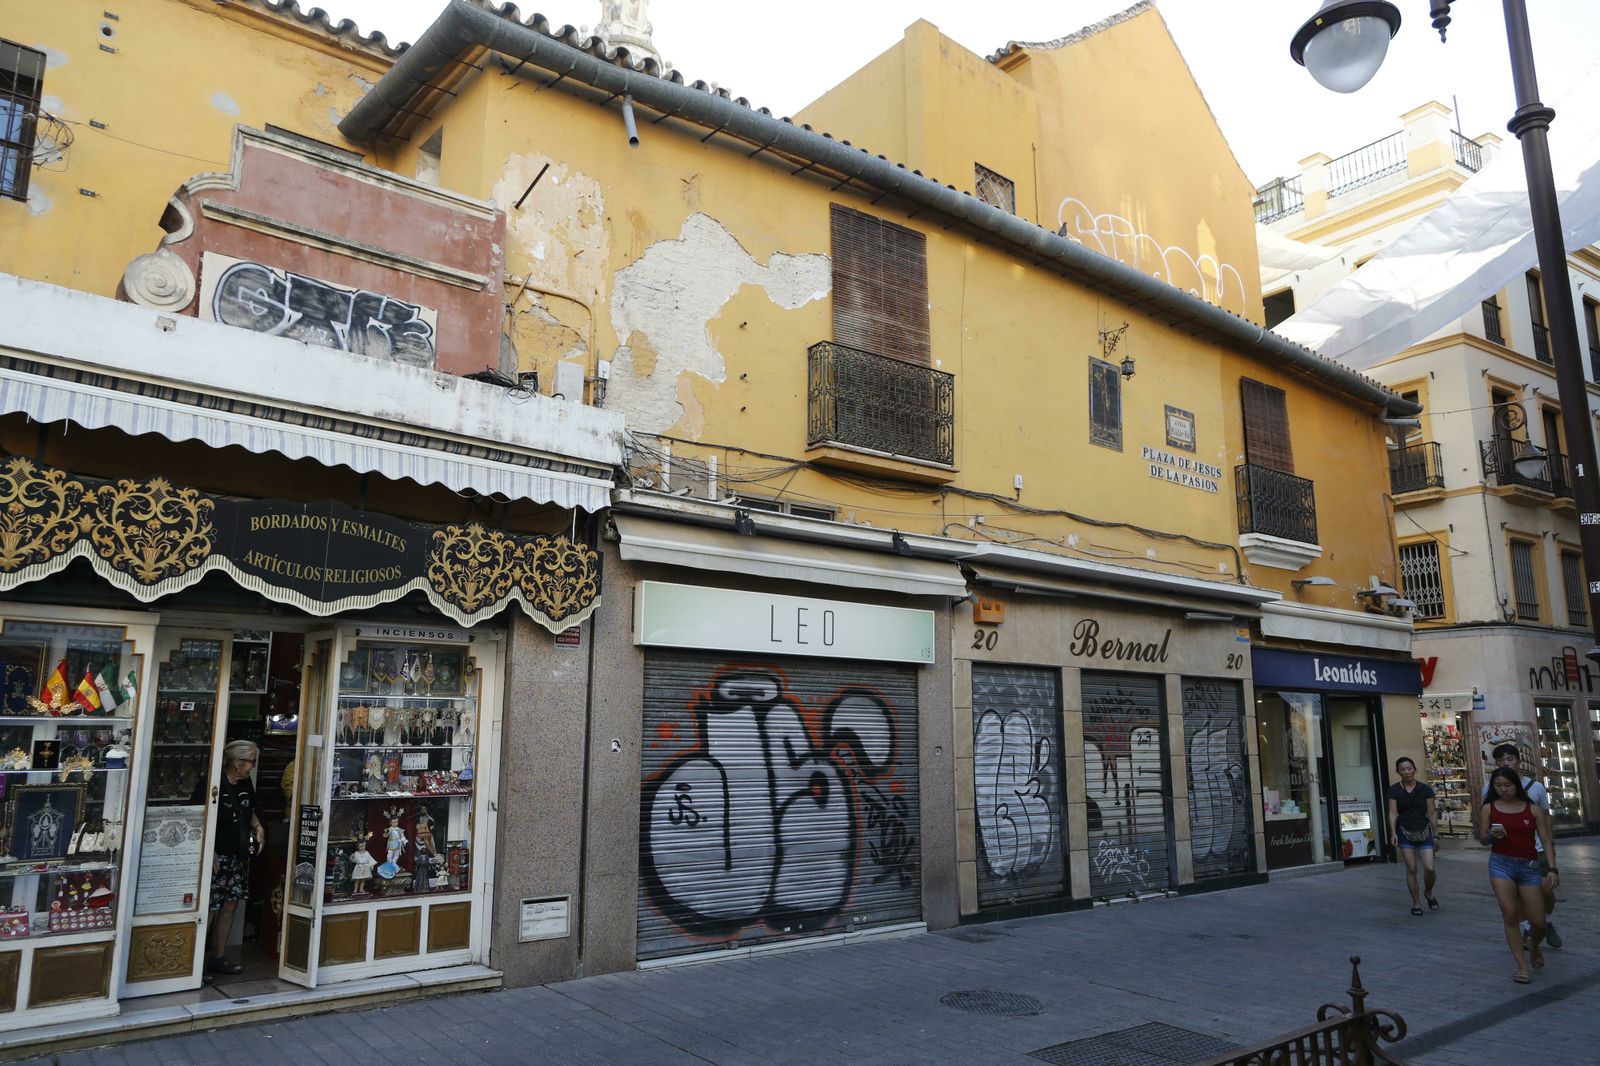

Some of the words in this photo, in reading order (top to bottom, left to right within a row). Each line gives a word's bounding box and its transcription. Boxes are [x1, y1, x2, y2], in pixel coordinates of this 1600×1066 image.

[1142, 447, 1175, 466] PLAZA
[1178, 457, 1191, 470] DE
[1193, 461, 1222, 479] JESUS
[1150, 465, 1164, 478] DE
[1166, 469, 1180, 483] LA
[1182, 474, 1218, 492] PASION
[250, 514, 328, 532] BORDADOS
[330, 517, 342, 532] Y
[342, 520, 407, 553] ESMALTES
[243, 550, 322, 582] ARTÍCULOS
[325, 565, 402, 584] RELIGIOSOS
[376, 628, 454, 640] INCIENSOS
[770, 604, 835, 647] LEO
[971, 629, 999, 651] 20
[1070, 618, 1172, 664] Bernal
[1225, 653, 1244, 671] 20
[1313, 658, 1377, 686] Leonidas
